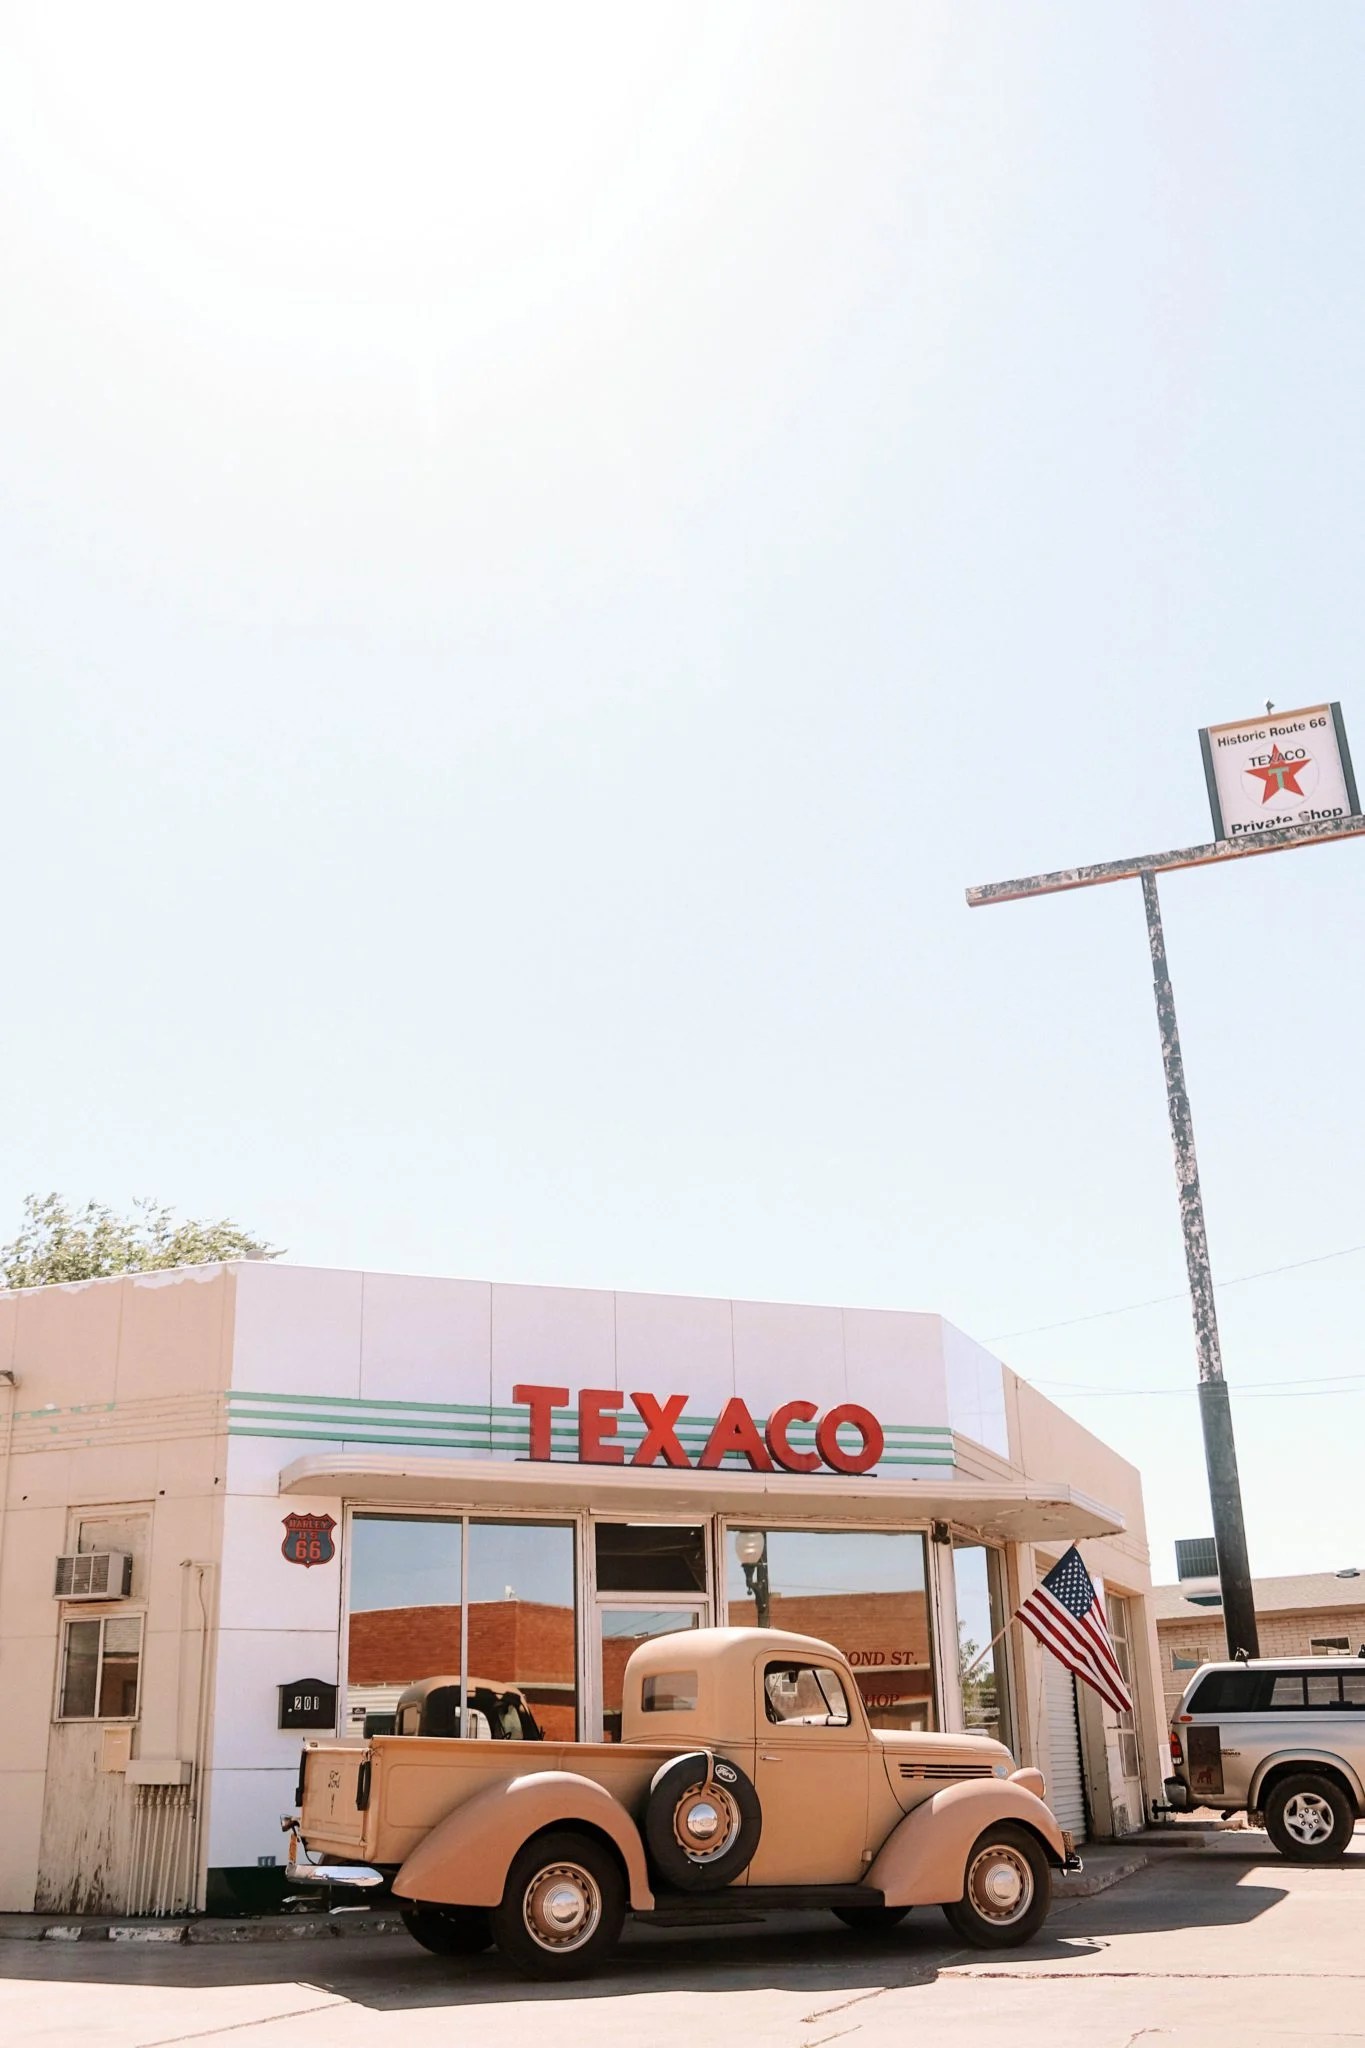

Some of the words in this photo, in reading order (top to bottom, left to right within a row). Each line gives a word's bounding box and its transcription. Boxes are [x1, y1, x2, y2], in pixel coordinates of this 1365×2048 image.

[1217, 730, 1266, 748] Historic
[1269, 721, 1306, 737] Route
[1309, 717, 1327, 729] 66
[1248, 748, 1306, 767] TEXACO
[1267, 766, 1290, 789] T
[1231, 815, 1293, 835] Private
[513, 1384, 884, 1474] TEXACO
[295, 1540, 321, 1560] 66
[841, 1651, 885, 1666] OND
[890, 1651, 918, 1666] ST.
[863, 1693, 900, 1708] HOP
